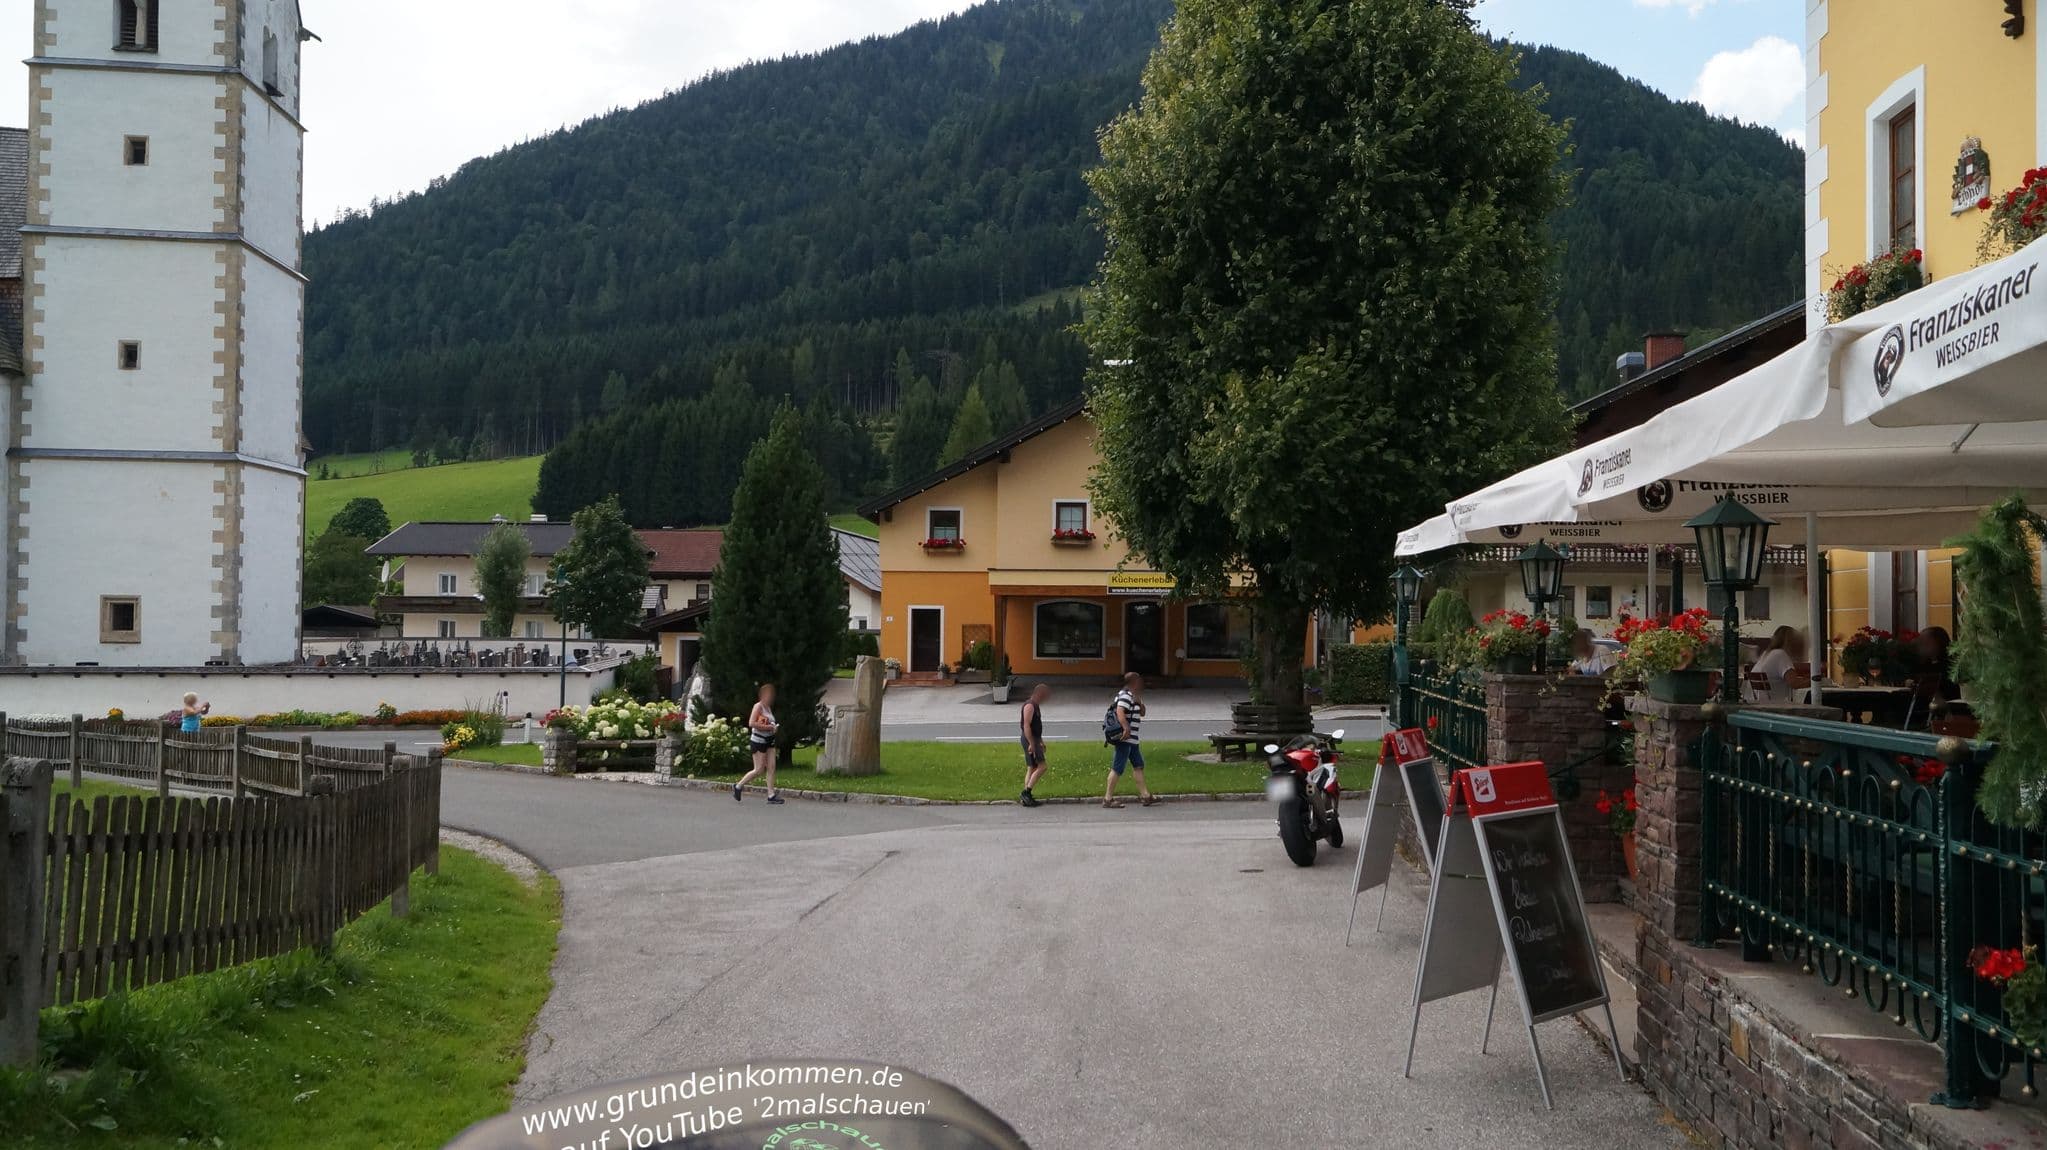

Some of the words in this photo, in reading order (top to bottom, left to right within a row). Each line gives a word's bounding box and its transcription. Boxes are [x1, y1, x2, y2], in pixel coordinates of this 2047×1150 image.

[1909, 262, 2038, 353] Franziskaner
[1936, 322, 1999, 368] WEISSBIER
[1714, 492, 1789, 504] WISSBIER
[1549, 528, 1600, 537] WEISSBIER
